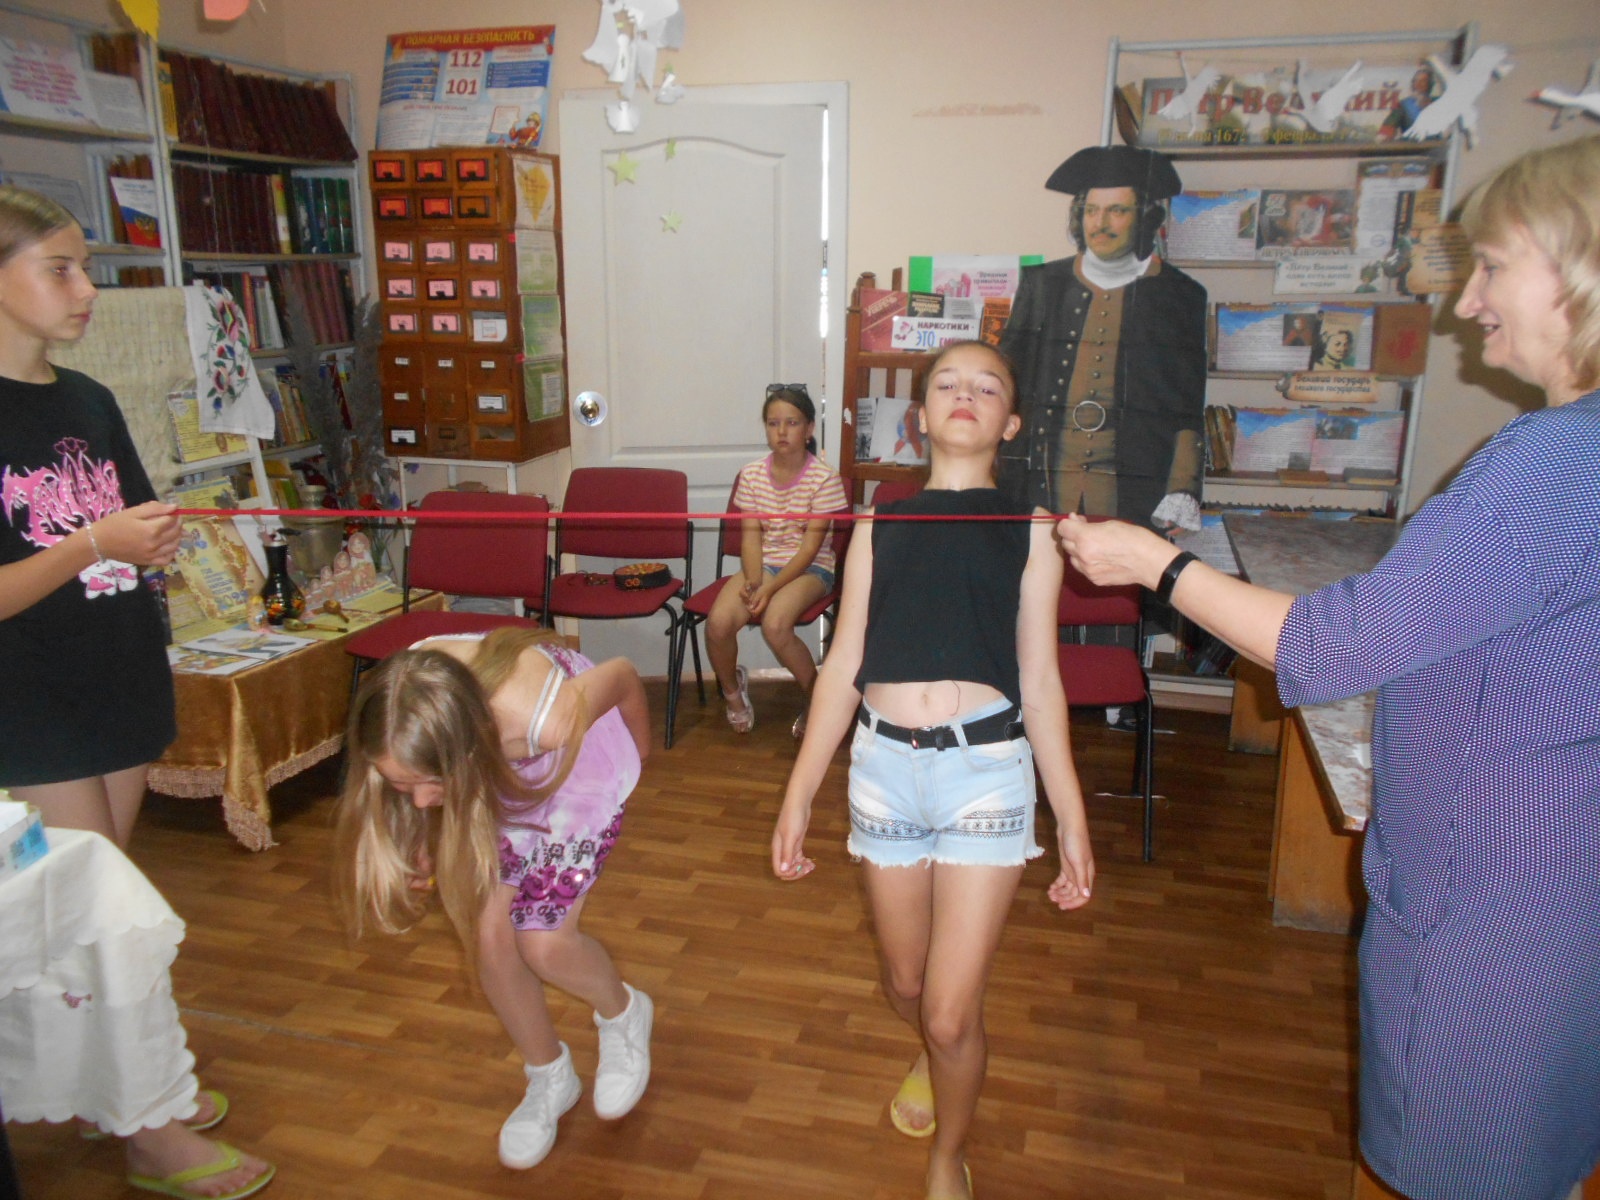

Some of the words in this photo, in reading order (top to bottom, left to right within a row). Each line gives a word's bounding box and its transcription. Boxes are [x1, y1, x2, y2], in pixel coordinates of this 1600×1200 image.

[405, 34, 460, 46] ПОЖАРНАЯ
[463, 30, 535, 44] БЕЗОПАСНОСТЬ
[450, 52, 482, 67] 112
[445, 79, 477, 95] 101
[917, 321, 969, 330] НАРКОТИКИ
[916, 330, 935, 347] ЭТО
